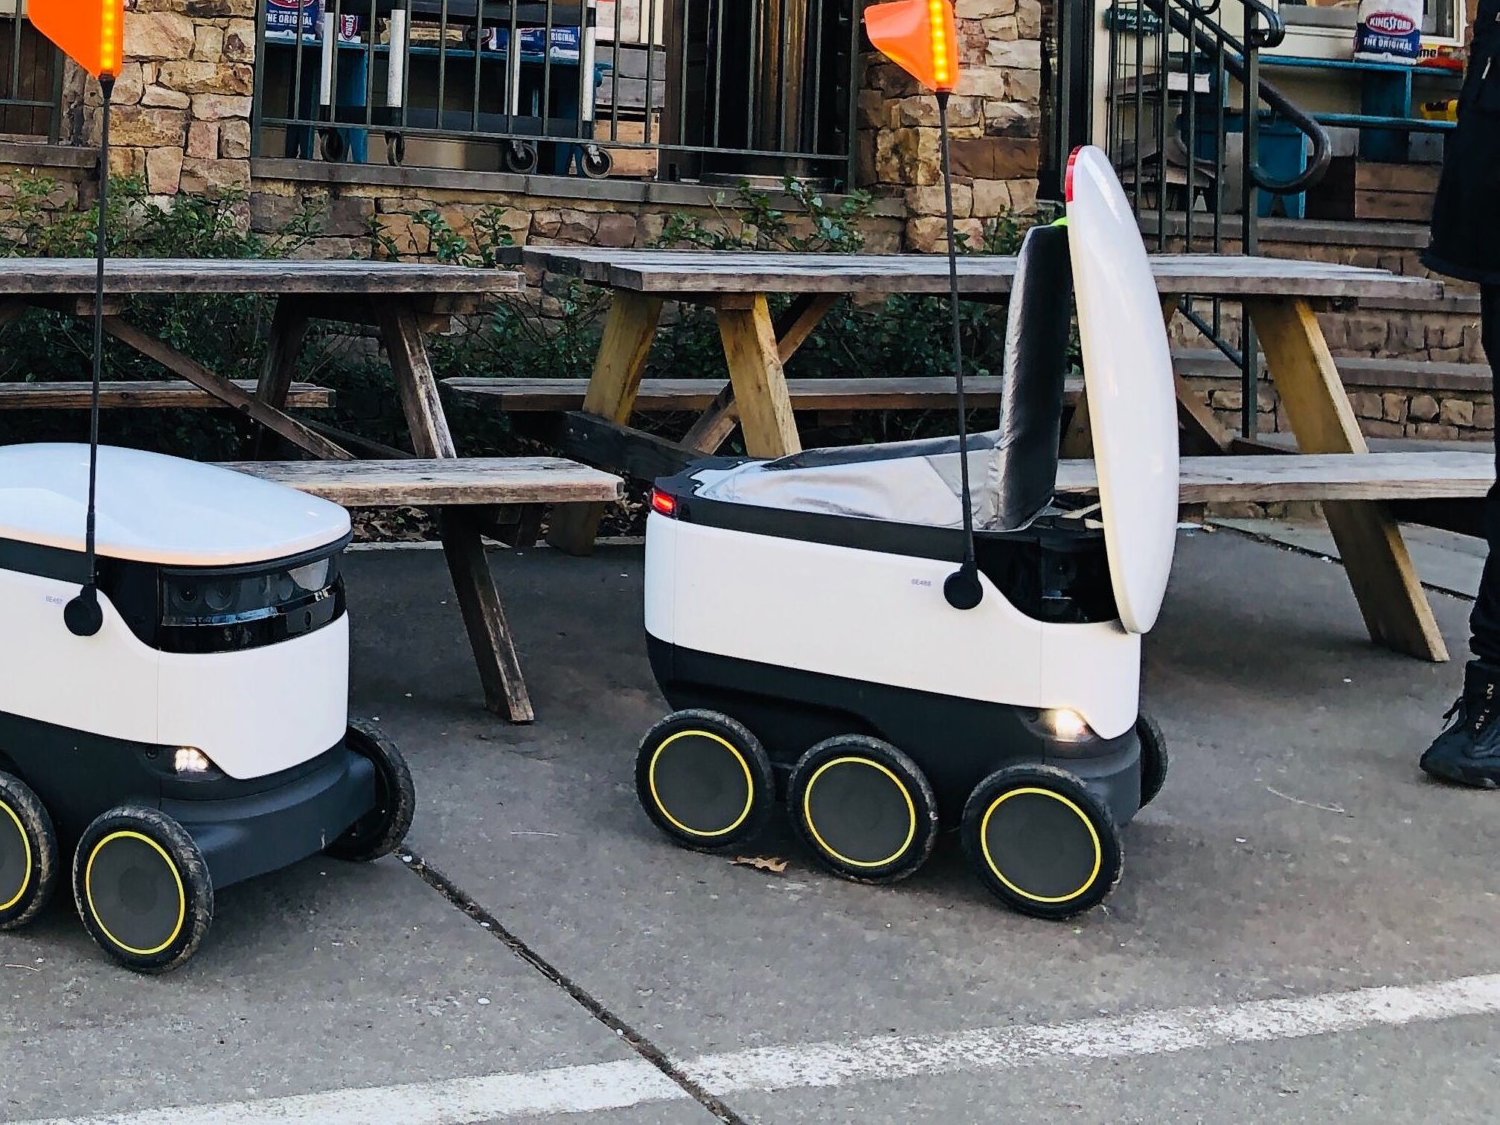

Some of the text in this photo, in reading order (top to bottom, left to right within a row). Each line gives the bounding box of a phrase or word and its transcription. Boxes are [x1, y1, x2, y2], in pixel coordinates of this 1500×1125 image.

[279, 14, 312, 26] ORIGAL
[1369, 15, 1412, 31] KINGSFORD
[550, 31, 576, 43] RIGINAL
[1363, 37, 1377, 47] THE
[1378, 39, 1413, 52] ORIGINAL
